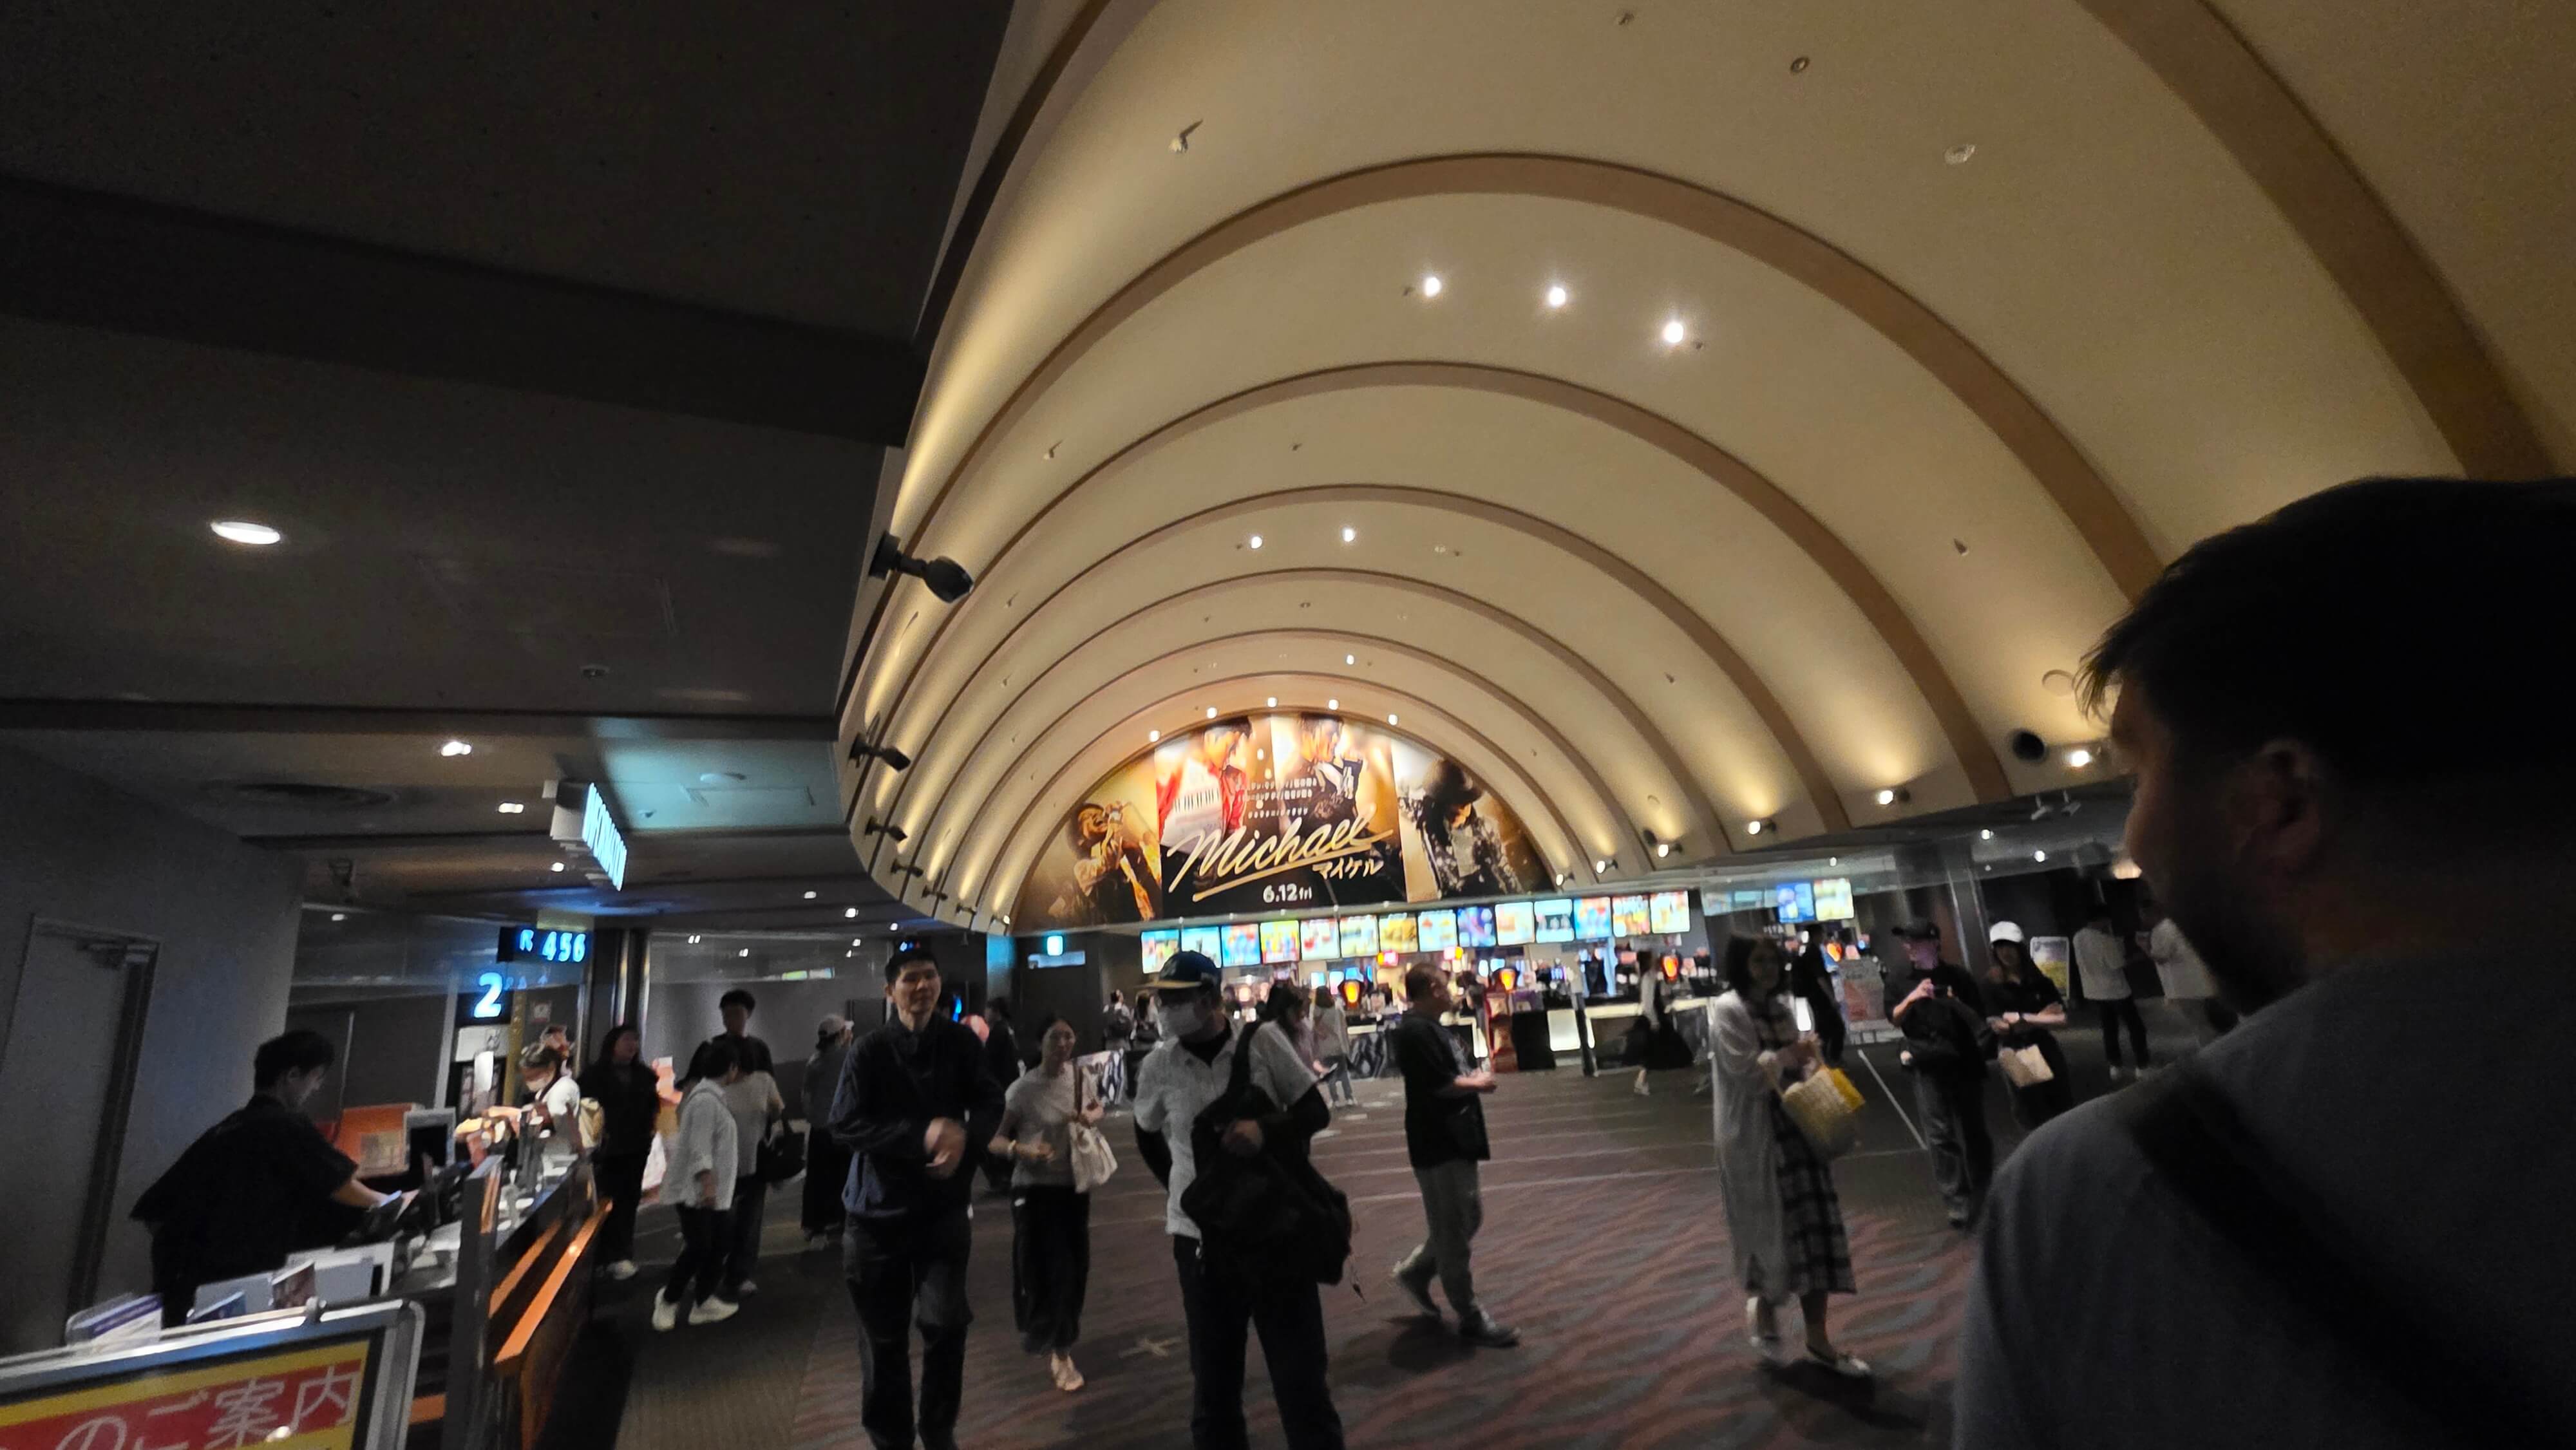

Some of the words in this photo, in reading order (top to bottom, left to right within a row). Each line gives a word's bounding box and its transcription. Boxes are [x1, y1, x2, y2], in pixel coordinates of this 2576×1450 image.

[1167, 816, 1393, 893] Michael
[1312, 857, 1383, 880] マイケル
[474, 972, 503, 1018] 2
